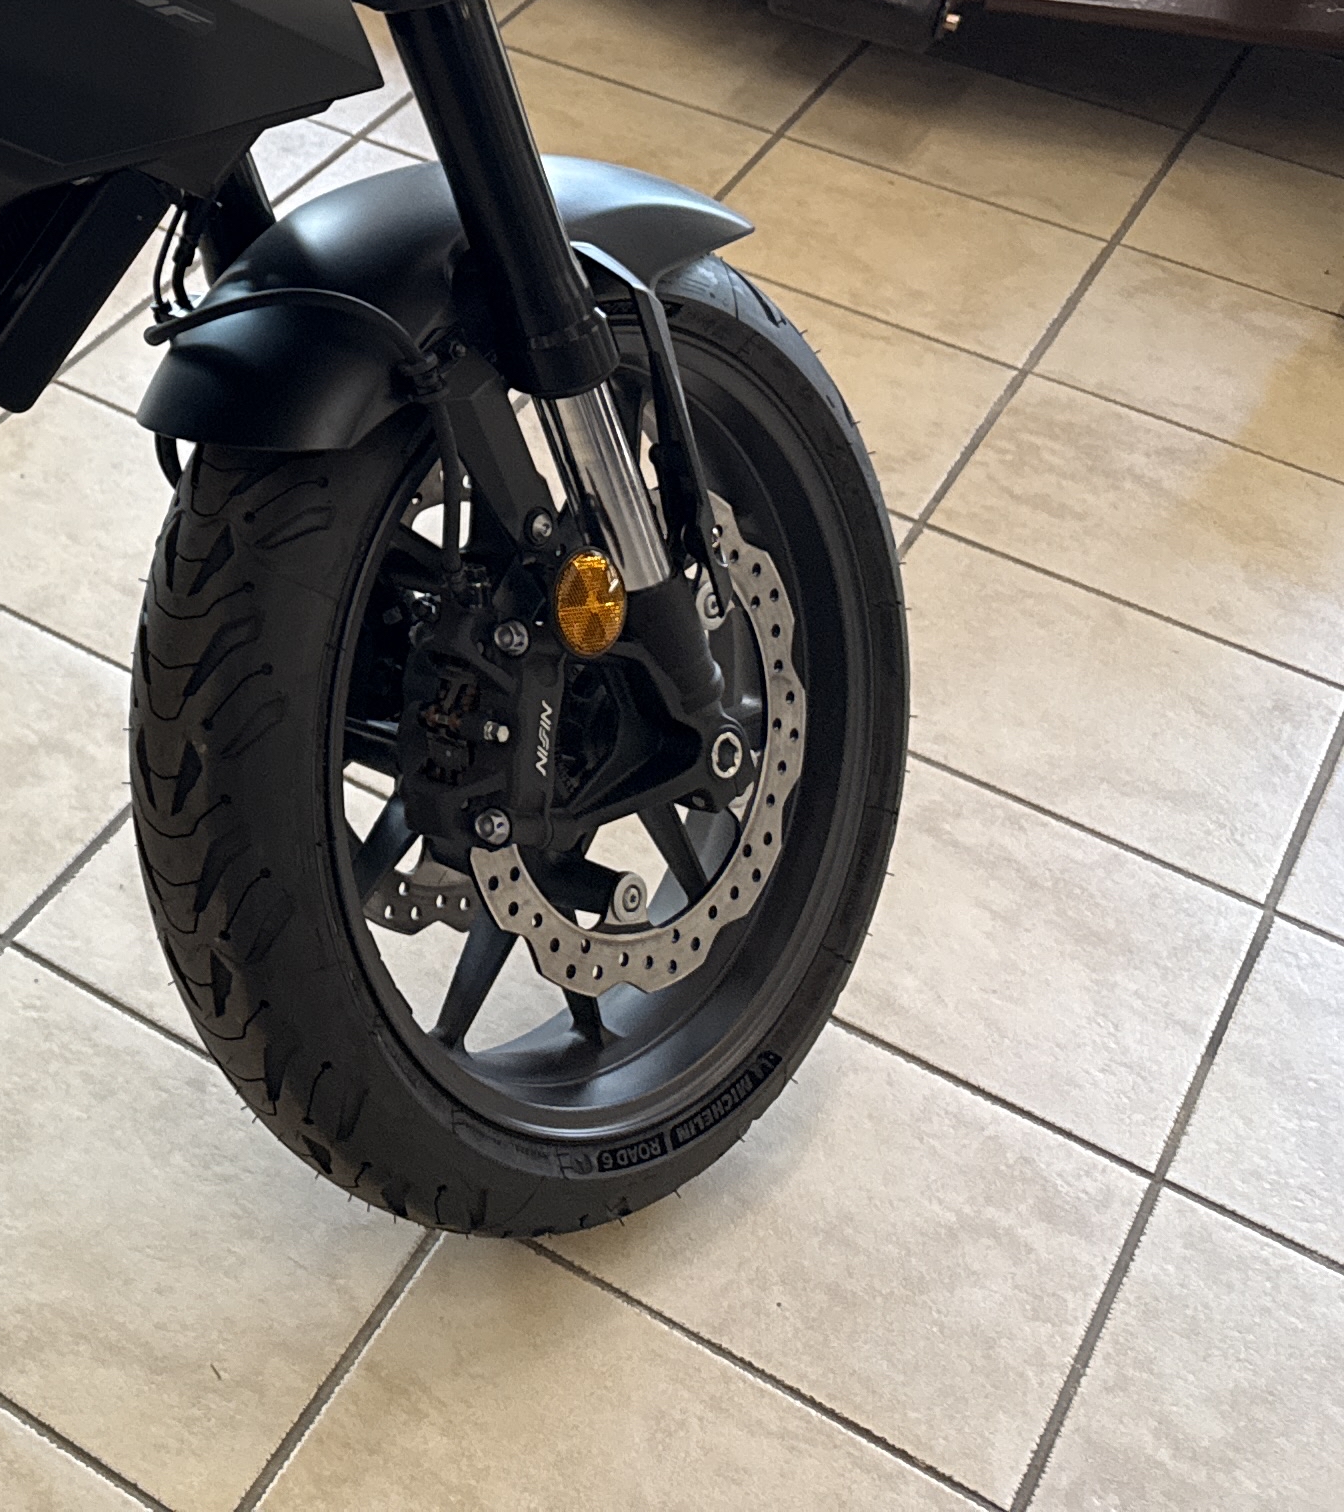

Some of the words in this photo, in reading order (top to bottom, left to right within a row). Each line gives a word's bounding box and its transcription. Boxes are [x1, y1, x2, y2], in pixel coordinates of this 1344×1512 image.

[535, 699, 553, 777] NISSIN
[676, 1068, 754, 1143] MICHELIN
[601, 1152, 614, 1169] 6
[618, 1137, 662, 1166] ROAD
